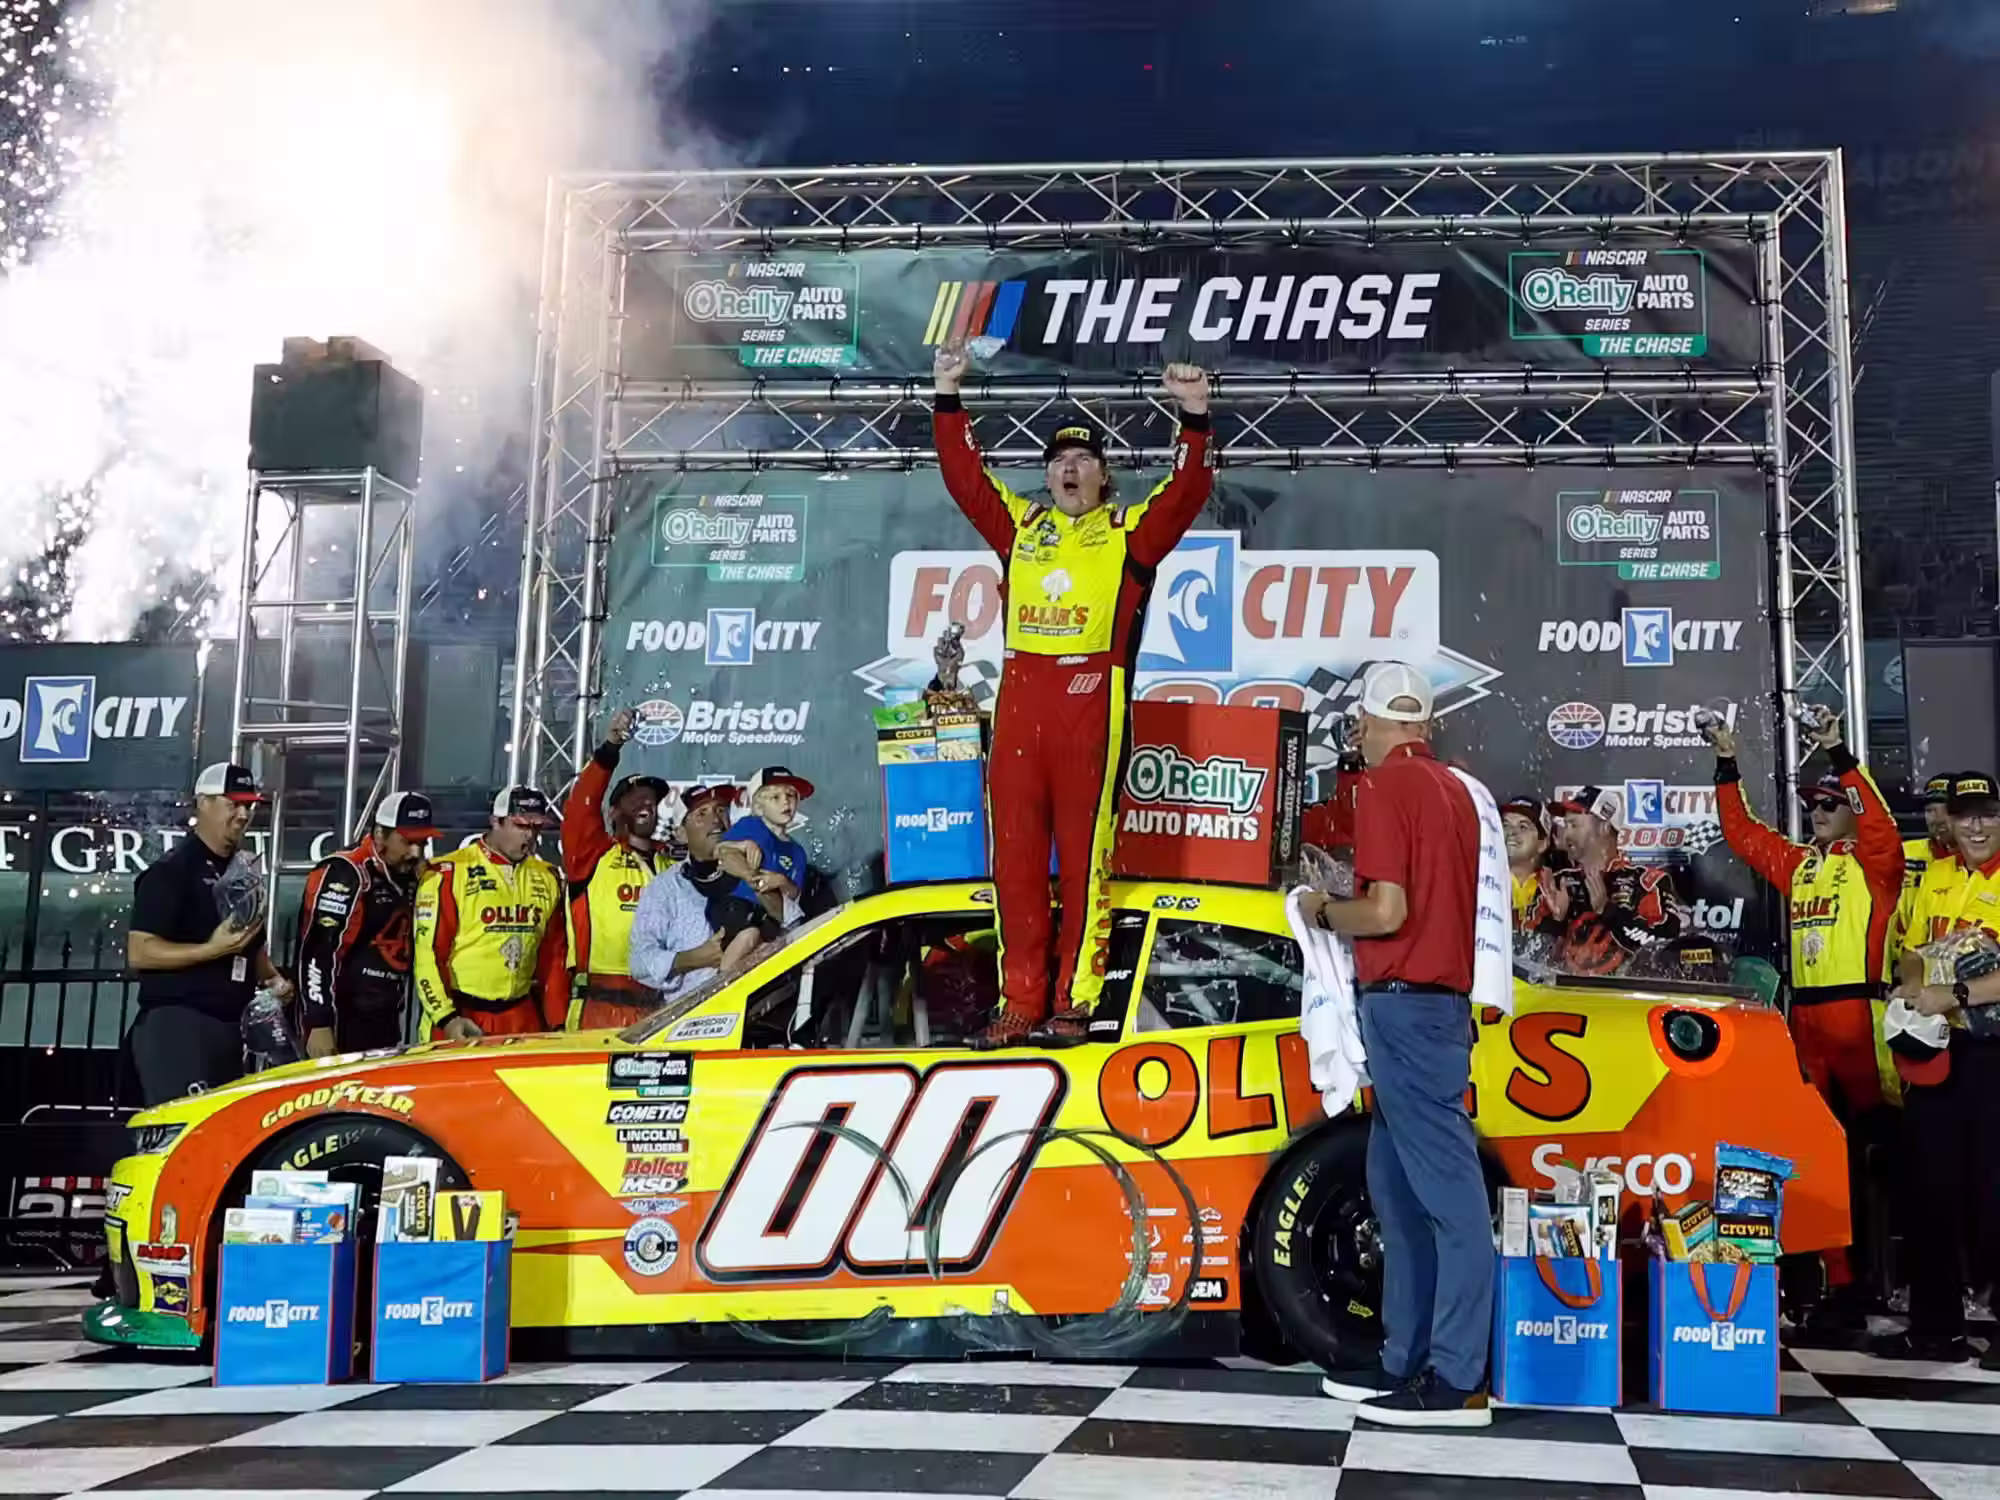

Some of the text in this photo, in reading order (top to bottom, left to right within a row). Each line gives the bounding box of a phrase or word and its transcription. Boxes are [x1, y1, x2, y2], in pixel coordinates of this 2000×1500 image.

[1586, 251, 1647, 265] NASCAR
[745, 262, 806, 278] NASCAR
[1521, 268, 1636, 312] O'Reilly
[1643, 275, 1688, 291] AUTO
[684, 280, 793, 324] O'Reilly
[798, 287, 843, 304] AUTO
[1637, 292, 1694, 309] PARTS
[792, 303, 847, 321] PARTS
[1043, 274, 1441, 344] THE CHASE
[1585, 317, 1630, 331] SERIES
[741, 330, 786, 342] SERIES
[1600, 336, 1693, 353] THE CHASE
[753, 348, 842, 365] THE CHASE
[714, 495, 764, 507] NASCAR
[1619, 490, 1672, 503] NASCAR
[757, 514, 794, 529] AUTO
[1567, 505, 1662, 545] O'Reilly
[1667, 511, 1706, 525] AUTO
[663, 509, 754, 546] O'Reilly
[752, 528, 797, 543] PARTS
[1662, 525, 1710, 540] PARTS
[709, 550, 747, 561] SERIES
[1619, 548, 1658, 559] SERIES
[719, 565, 794, 580] THE CHASE
[1631, 563, 1709, 578] THE CHASE
[904, 565, 1002, 640] FO
[1242, 564, 1416, 640] CITY
[626, 620, 706, 652] FOOD
[755, 620, 822, 651] CITY
[1538, 620, 1622, 652] FOOD
[1673, 620, 1743, 651] CITY
[94, 696, 188, 739] CITY
[685, 701, 810, 732] Bristol
[1607, 703, 1738, 733] Bristl
[681, 731, 804, 746] Motor Speedway
[1605, 735, 1650, 747] Motor
[1127, 748, 1266, 812] O'Reilly
[1664, 791, 1716, 814] CITY
[896, 812, 974, 828] FOOD CITY
[1123, 810, 1259, 841] AUTO PARTS
[1680, 898, 1745, 930] stol
[261, 1081, 416, 1128] GOODYEAR
[608, 1102, 687, 1121] COMETIC
[618, 1129, 678, 1142] LINCOLN
[631, 1142, 683, 1153] WELDERS
[698, 1060, 1067, 1281] 00
[621, 1177, 681, 1193] MSD
[1273, 1175, 1310, 1268] EAGLE
[228, 1305, 319, 1322] FOOD CITY
[385, 1303, 473, 1320] FOOD CITY
[1516, 1320, 1609, 1339] FOOD CITY
[1673, 1326, 1766, 1344] FOOD CITY
